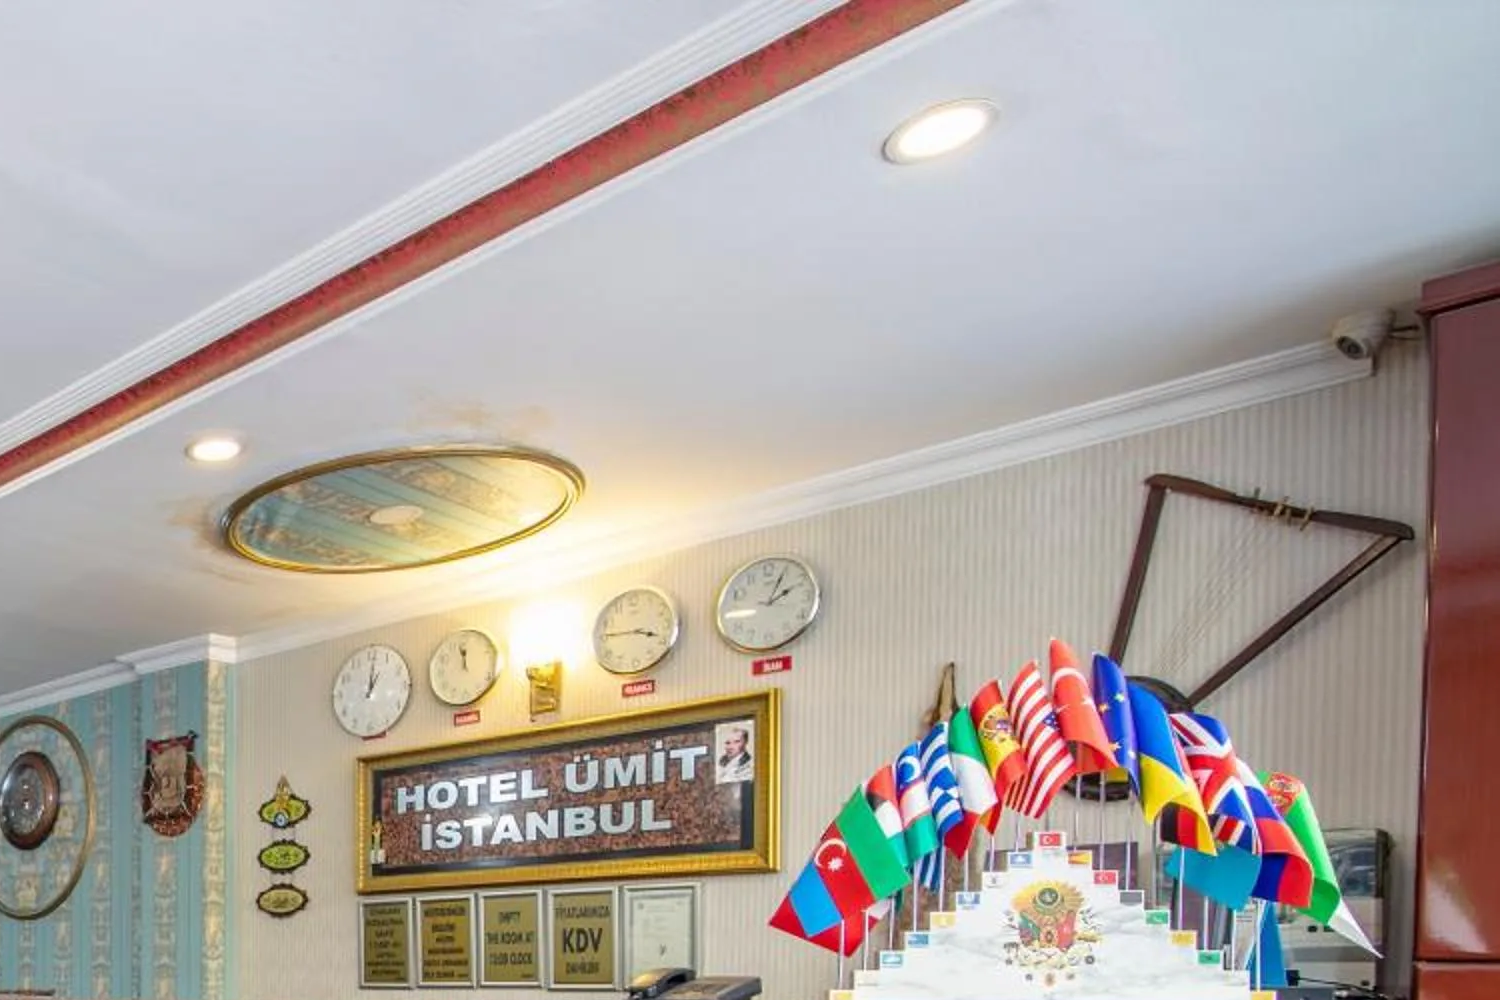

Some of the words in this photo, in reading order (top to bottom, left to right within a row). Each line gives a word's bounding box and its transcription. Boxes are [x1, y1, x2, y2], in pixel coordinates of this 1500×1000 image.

[396, 769, 548, 815] HOTEL
[564, 740, 709, 795] ÜMİT
[421, 798, 673, 852] İSTANBUL
[562, 927, 603, 954] KDV
